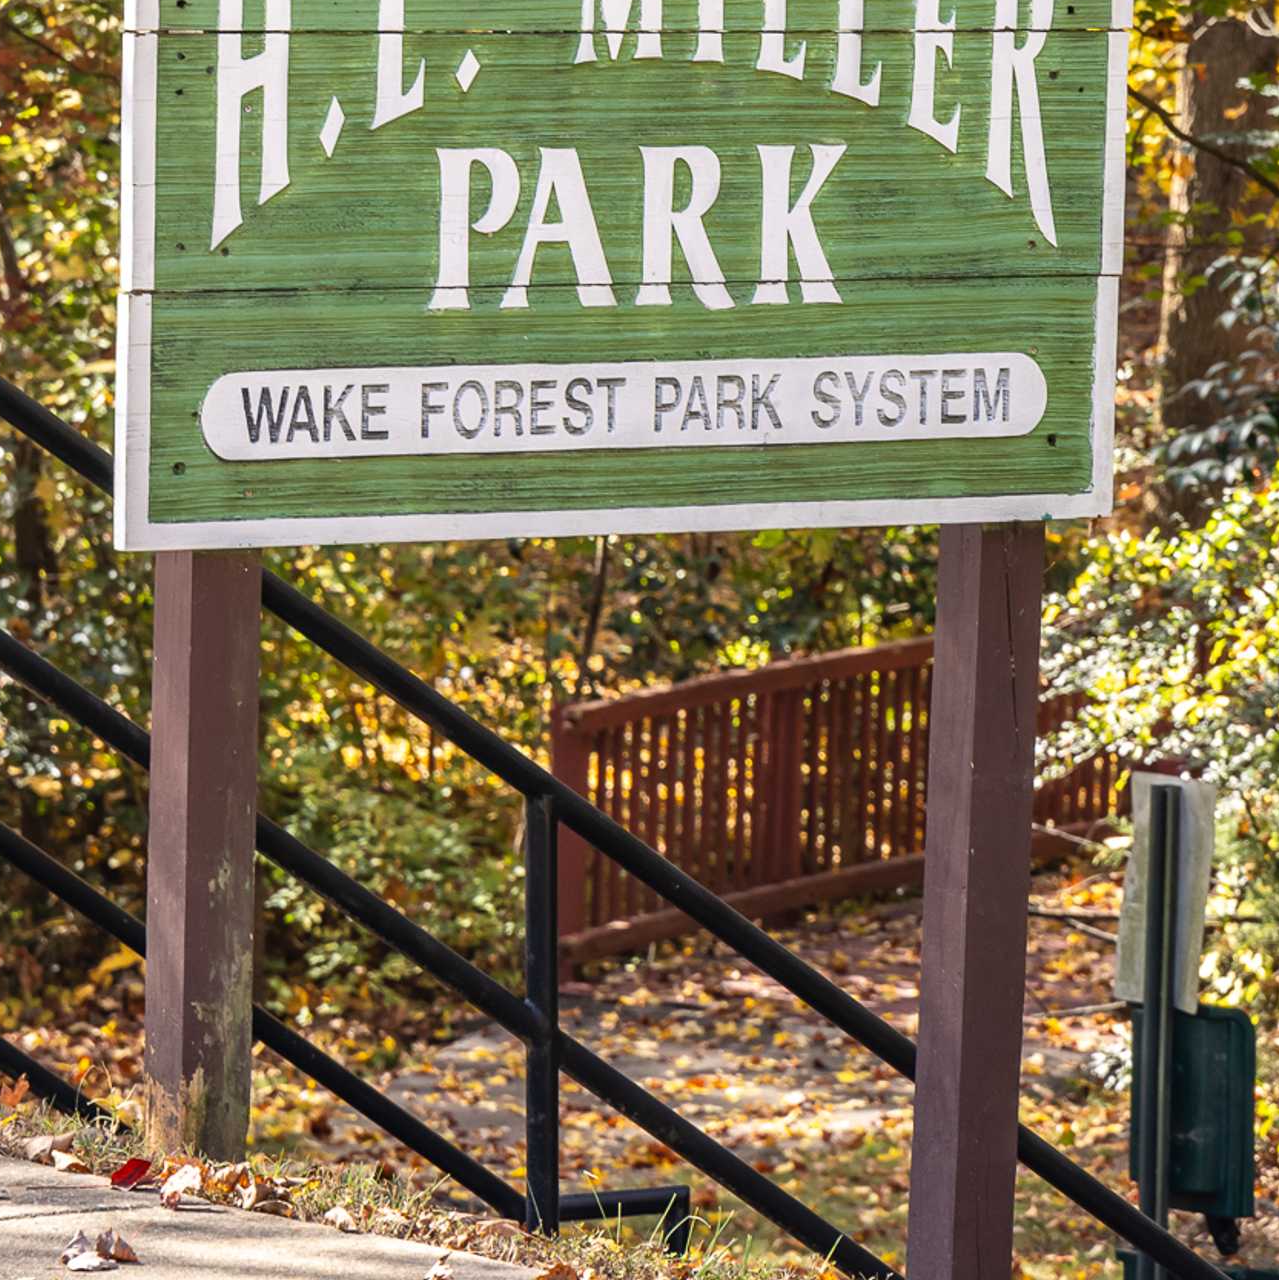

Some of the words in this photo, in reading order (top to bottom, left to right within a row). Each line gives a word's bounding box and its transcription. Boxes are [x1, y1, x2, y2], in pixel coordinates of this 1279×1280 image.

[429, 144, 847, 311] PARK
[242, 383, 389, 444] WAKE
[421, 377, 626, 438] FOREST
[654, 373, 783, 432] PARK
[812, 367, 1011, 428] SYSTEM
